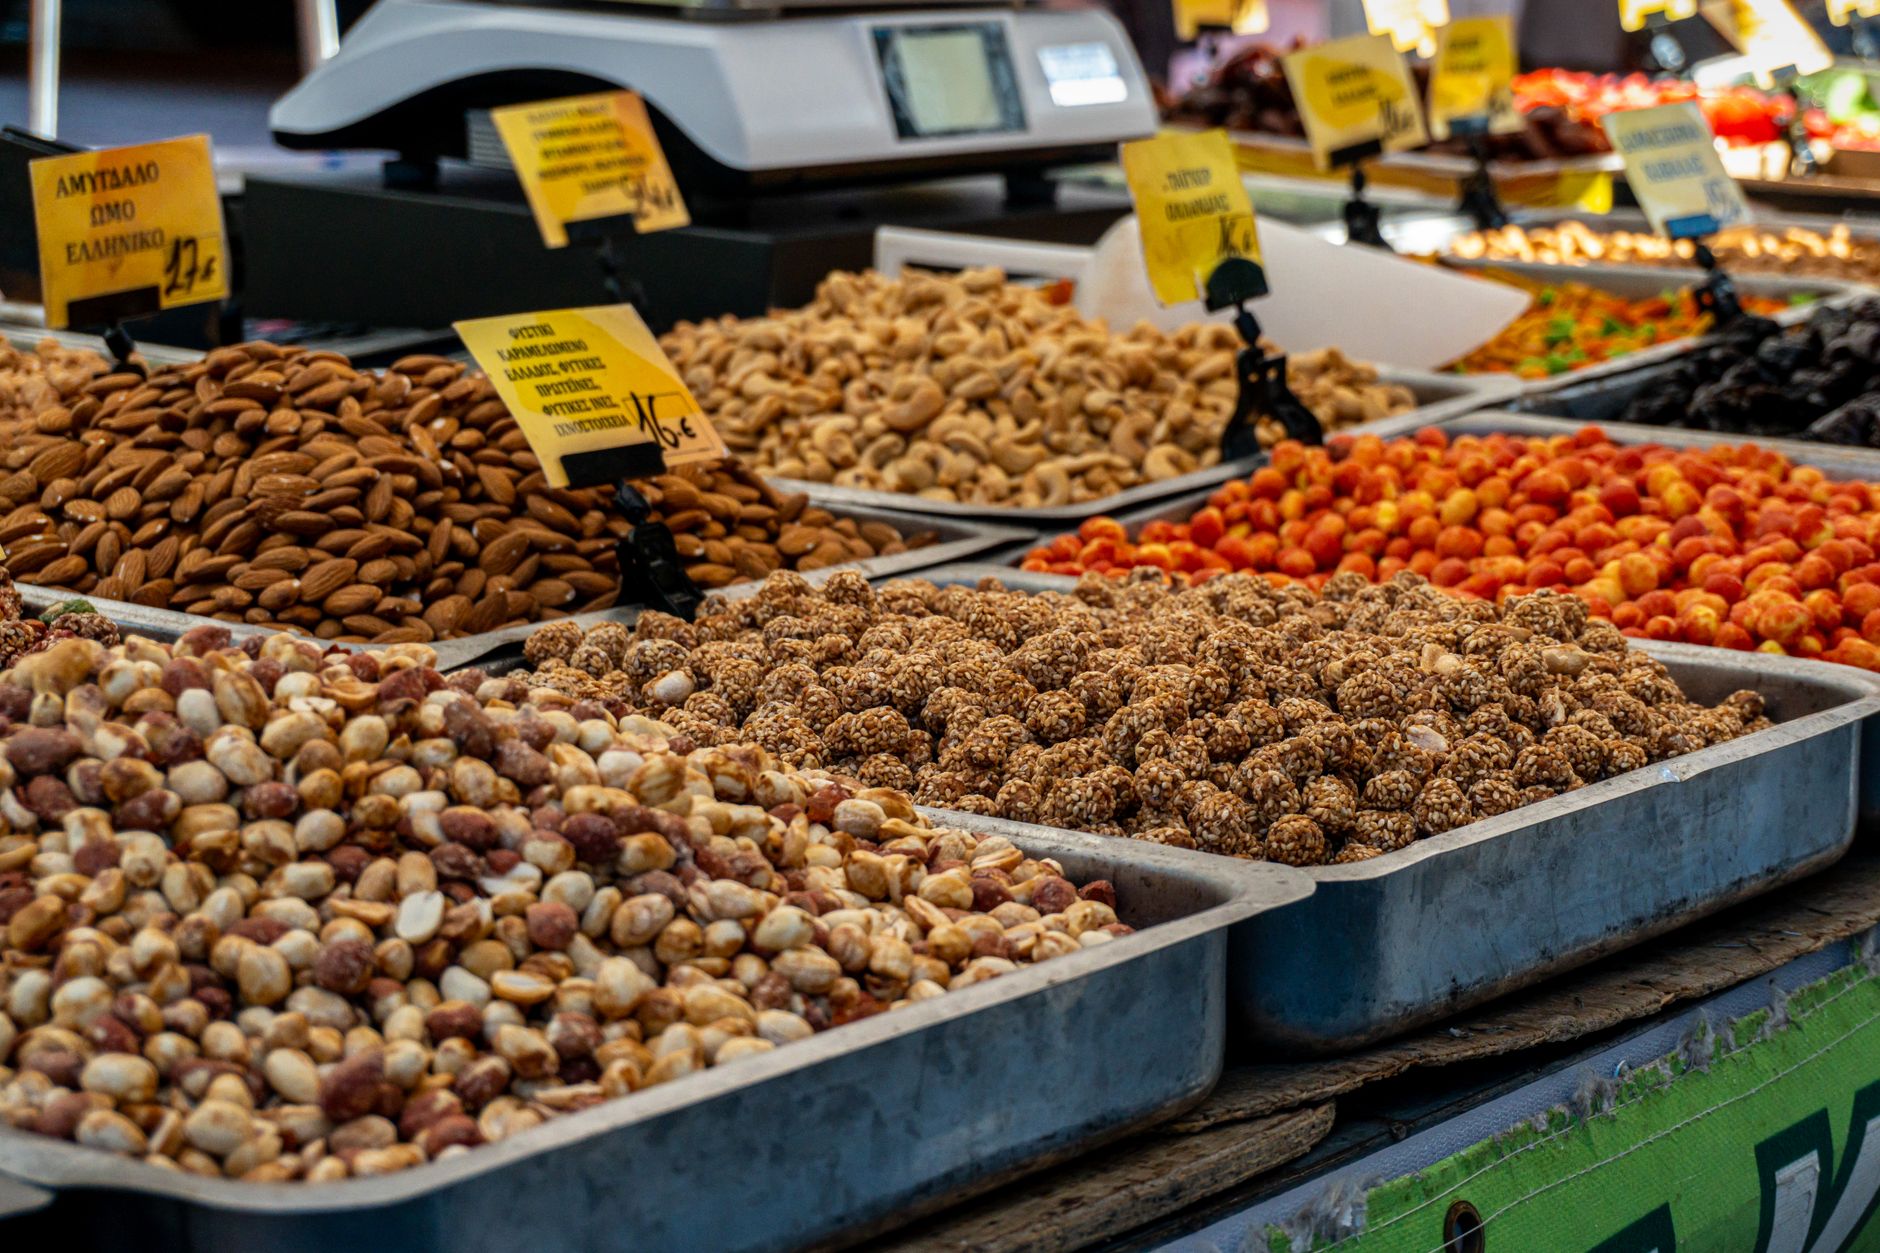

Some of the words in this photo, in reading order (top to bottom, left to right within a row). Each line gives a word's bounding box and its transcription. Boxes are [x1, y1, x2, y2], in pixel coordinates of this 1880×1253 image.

[56, 161, 160, 198] ΑΜΥΓΔΑΛΟ
[91, 199, 136, 227] ΩΜΟ
[66, 229, 164, 265] ΕΛΛΗΝΙΚΟ
[496, 339, 588, 361] ΚΑΡΑΜΕΛΩΜΕΝΟ
[543, 399, 592, 416] ΦΥΤΙΚΕΣ
[554, 414, 632, 437] ΙΧΝΟΣΤΟΙΧΕΙΑ
